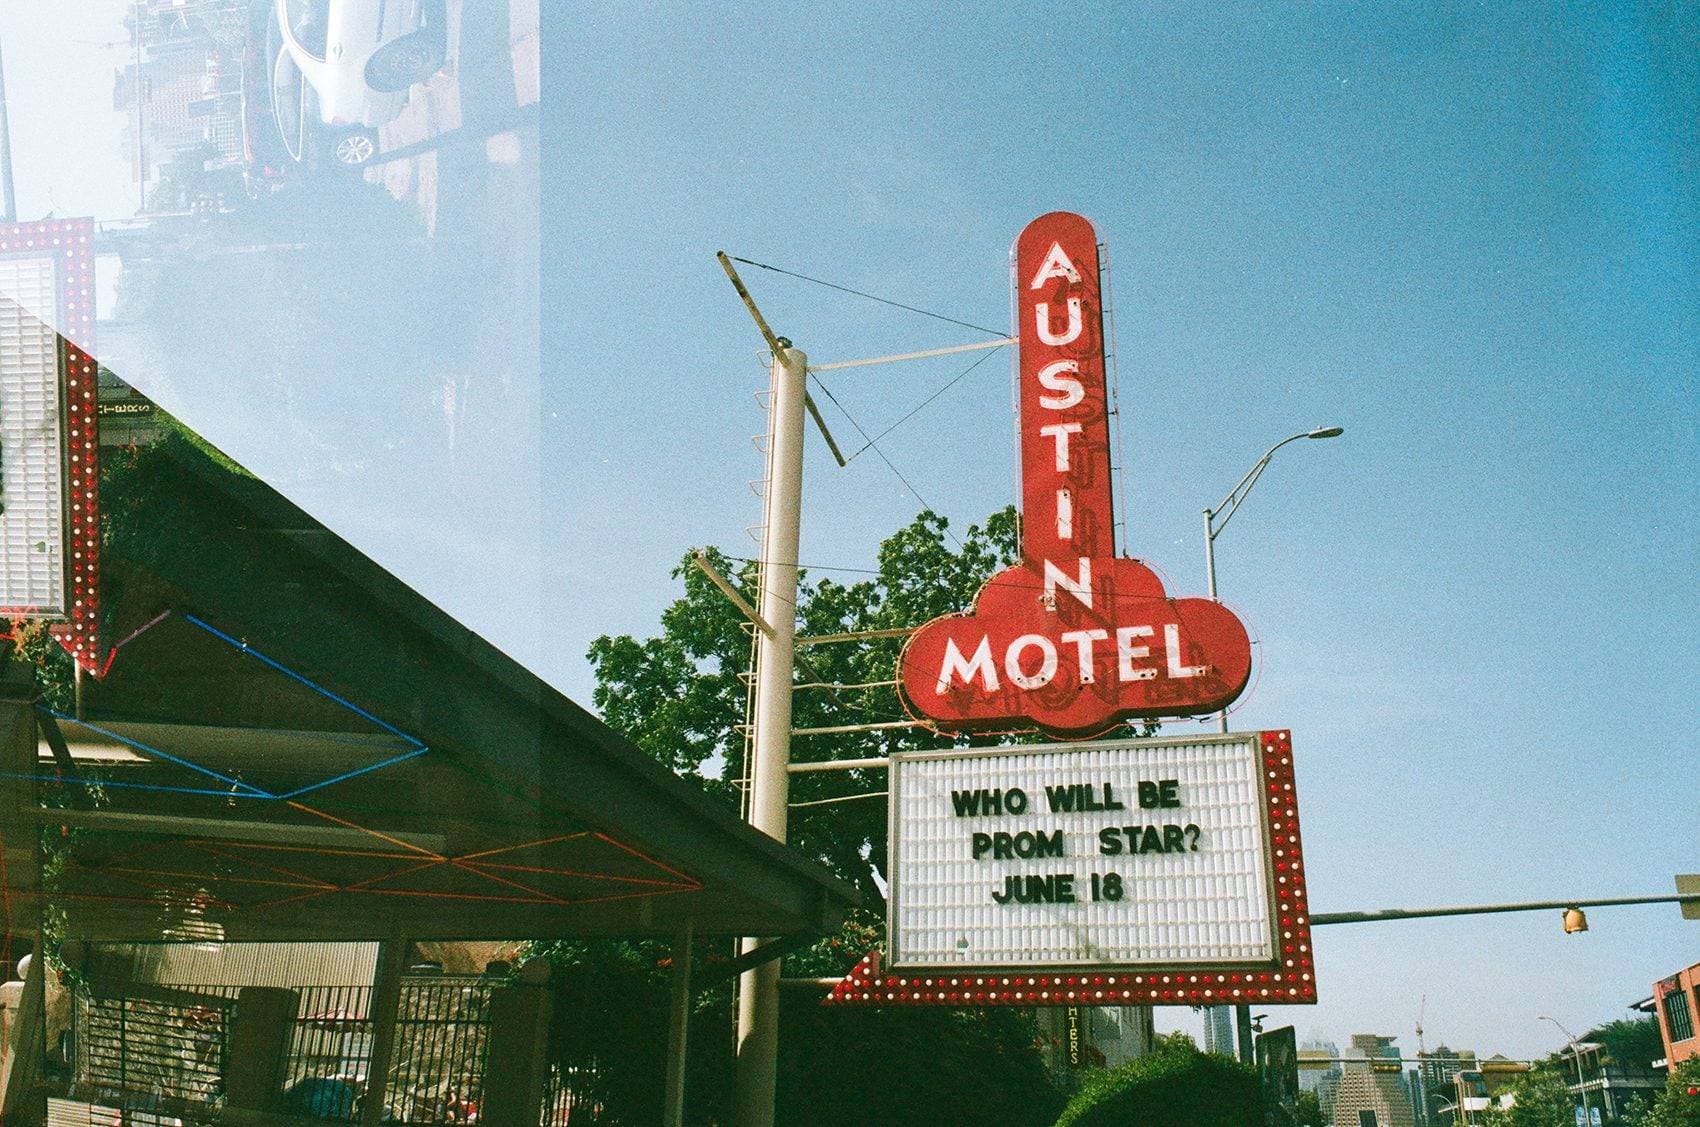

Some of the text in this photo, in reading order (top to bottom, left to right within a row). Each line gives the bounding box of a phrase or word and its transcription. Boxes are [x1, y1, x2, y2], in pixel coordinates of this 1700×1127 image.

[1031, 241, 1092, 611] AUSTIN
[936, 623, 1206, 695] MOTEL
[951, 779, 1180, 817] WHO WILL BE
[972, 823, 1201, 860] PROM STAR?
[992, 872, 1124, 904] JUNE 18
